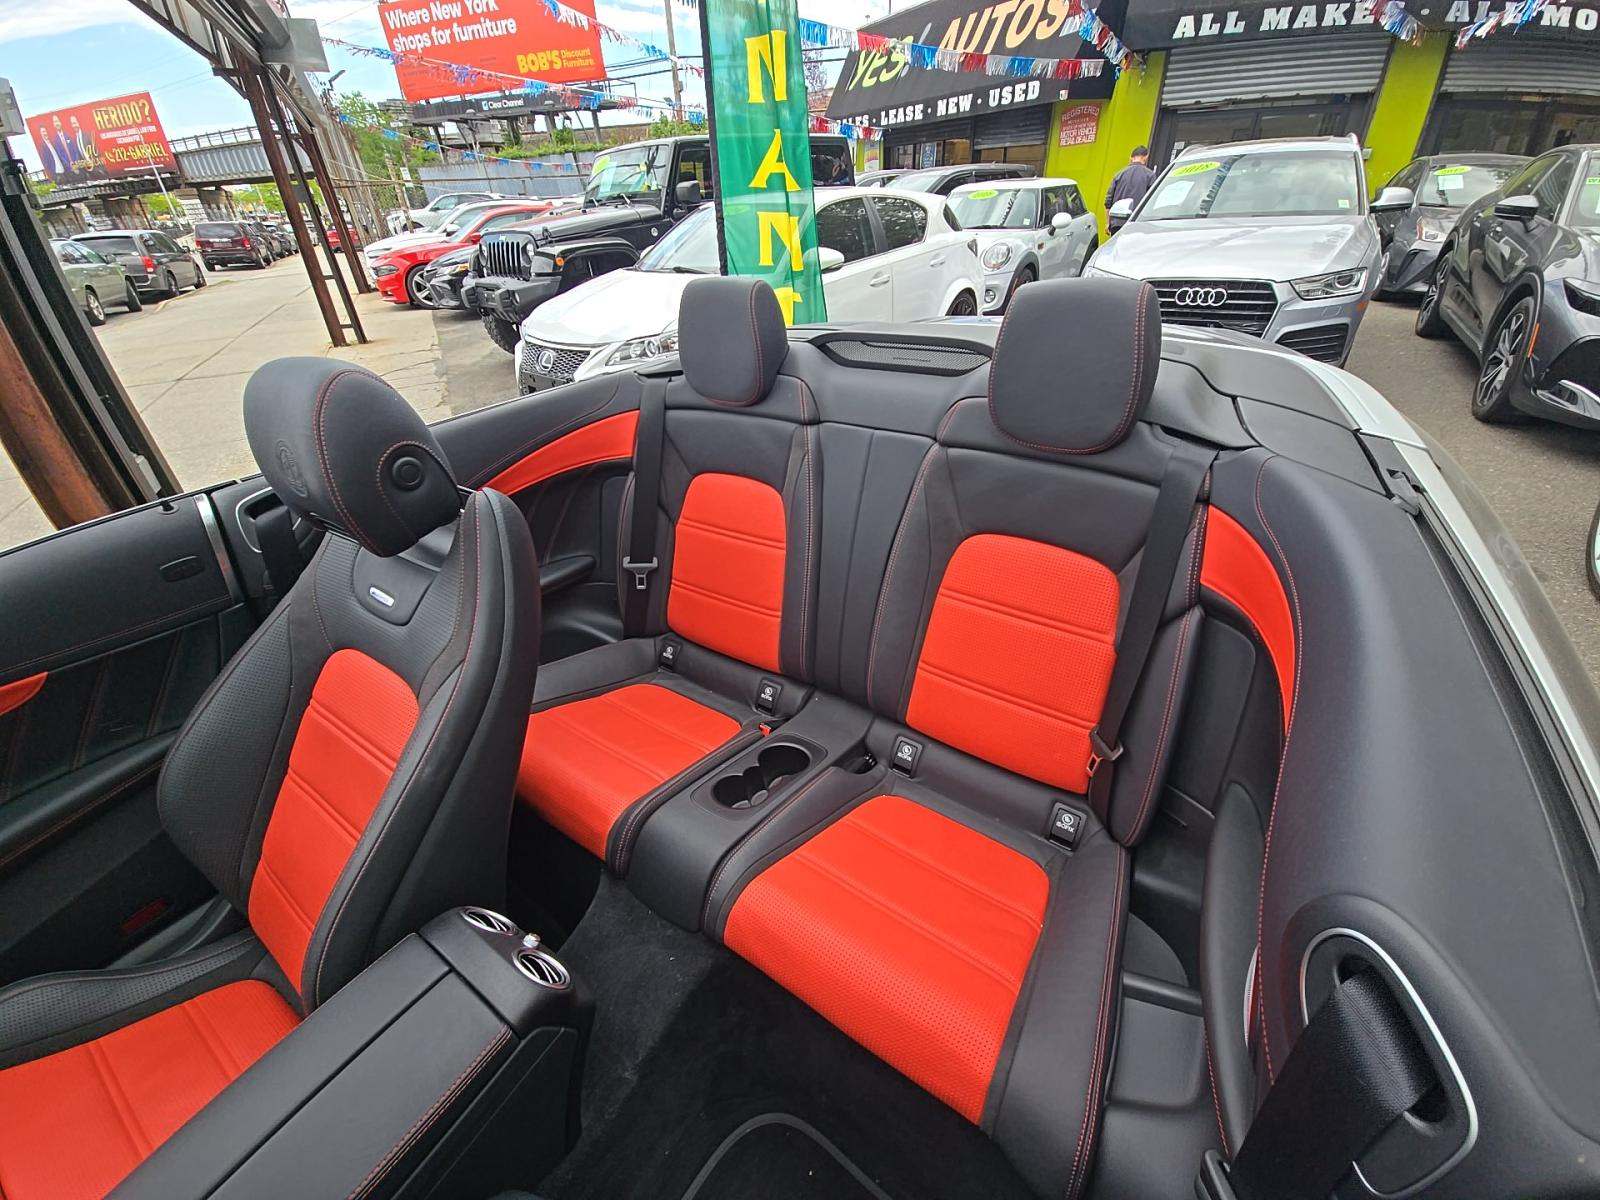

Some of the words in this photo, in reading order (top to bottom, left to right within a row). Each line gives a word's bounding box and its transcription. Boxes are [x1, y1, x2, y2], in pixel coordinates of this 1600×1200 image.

[385, 9, 430, 30] Where
[429, 1, 462, 21] New
[463, 0, 500, 15] York
[938, 0, 1070, 54] AUTOS
[1172, 11, 1246, 40] ALL
[1259, 0, 1401, 32] MAKE
[393, 32, 432, 53] shops
[431, 26, 452, 46] for
[452, 17, 517, 42] furniture
[516, 49, 562, 74] BOB'S
[560, 48, 591, 59] Discount
[880, 104, 924, 126] LEASE
[936, 94, 973, 116] NEW
[988, 80, 1041, 108] USED
